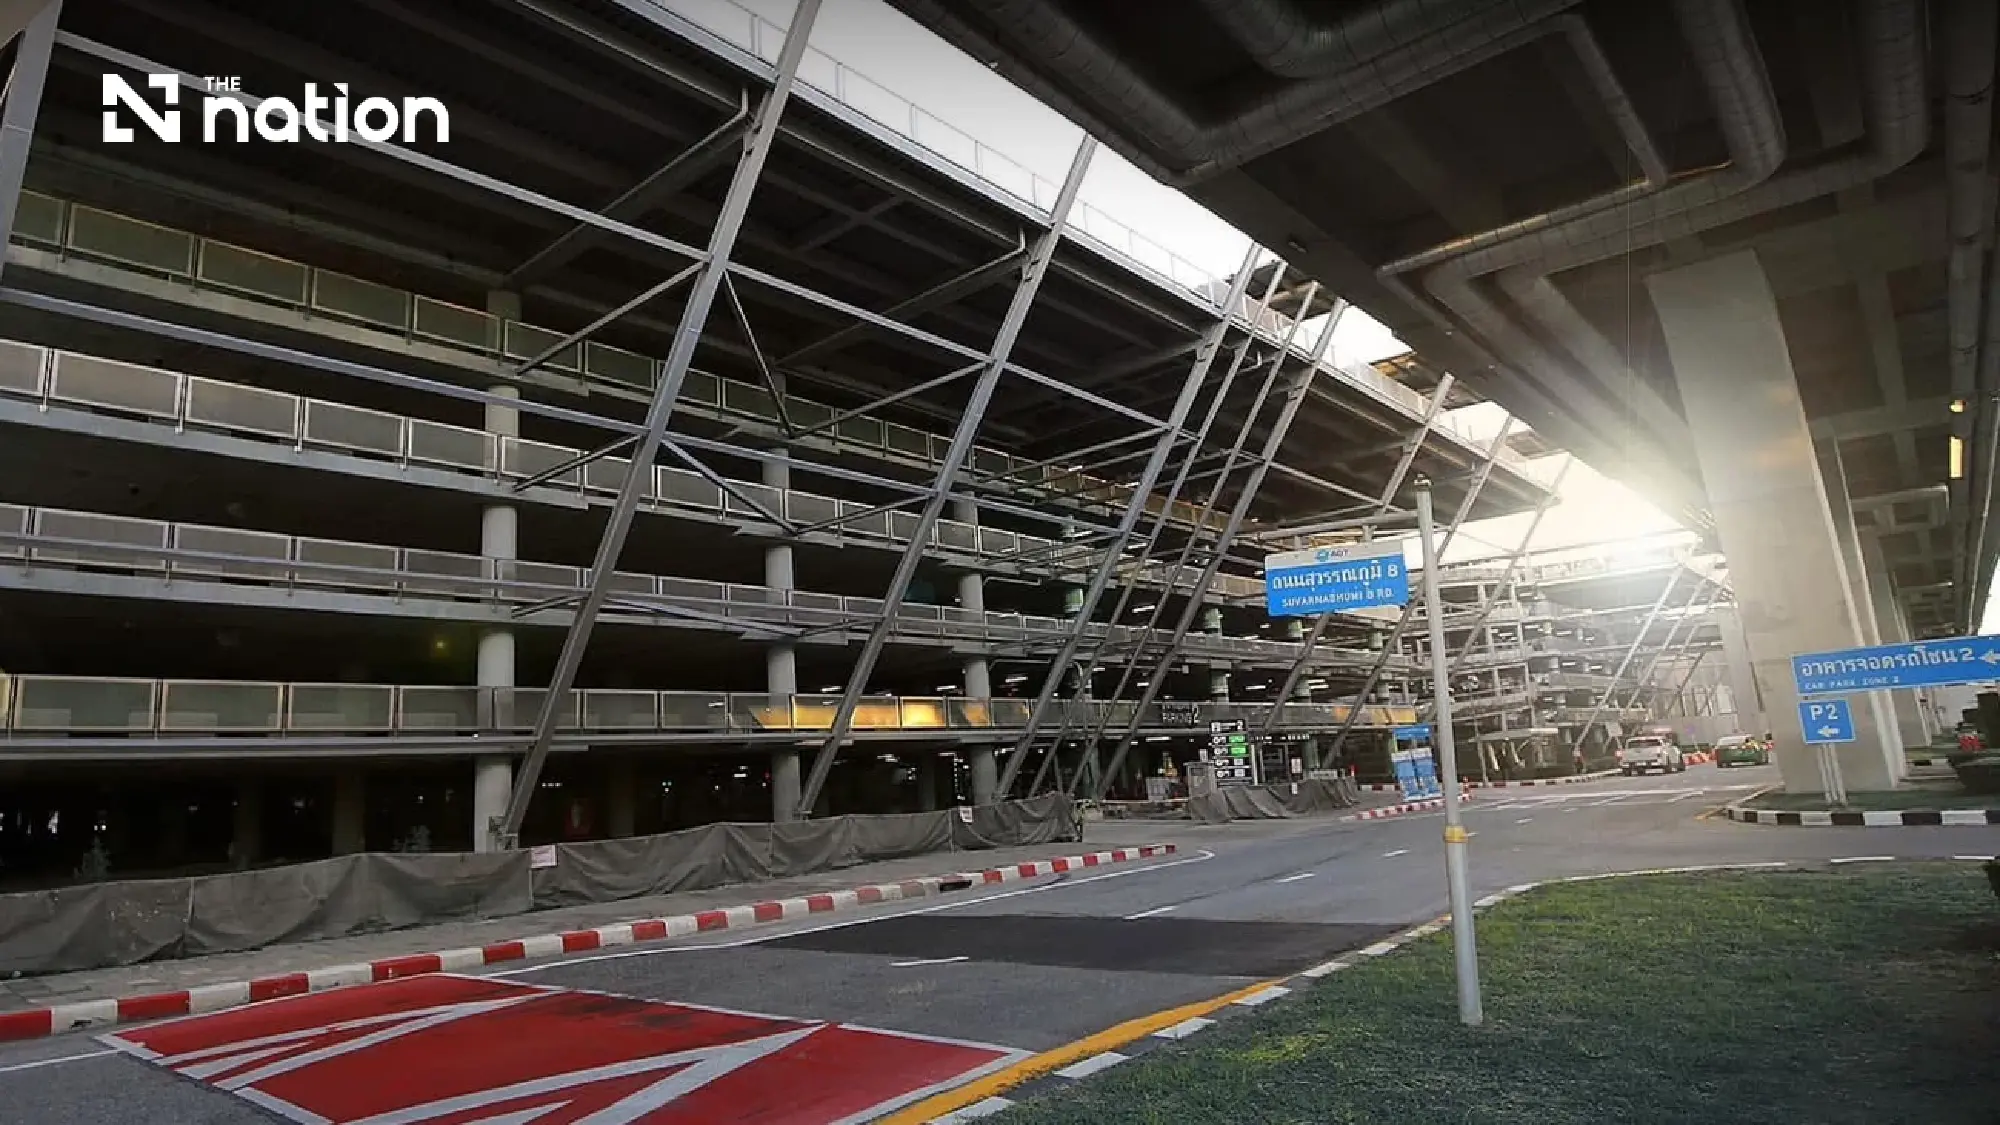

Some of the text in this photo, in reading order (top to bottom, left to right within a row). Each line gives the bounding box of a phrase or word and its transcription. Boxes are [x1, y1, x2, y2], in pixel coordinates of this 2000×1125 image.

[1273, 560, 1381, 591] ถนนสุวรรณภูมิ
[1282, 591, 1363, 607] SUVARNABHUMI
[1810, 704, 1838, 721] P2
